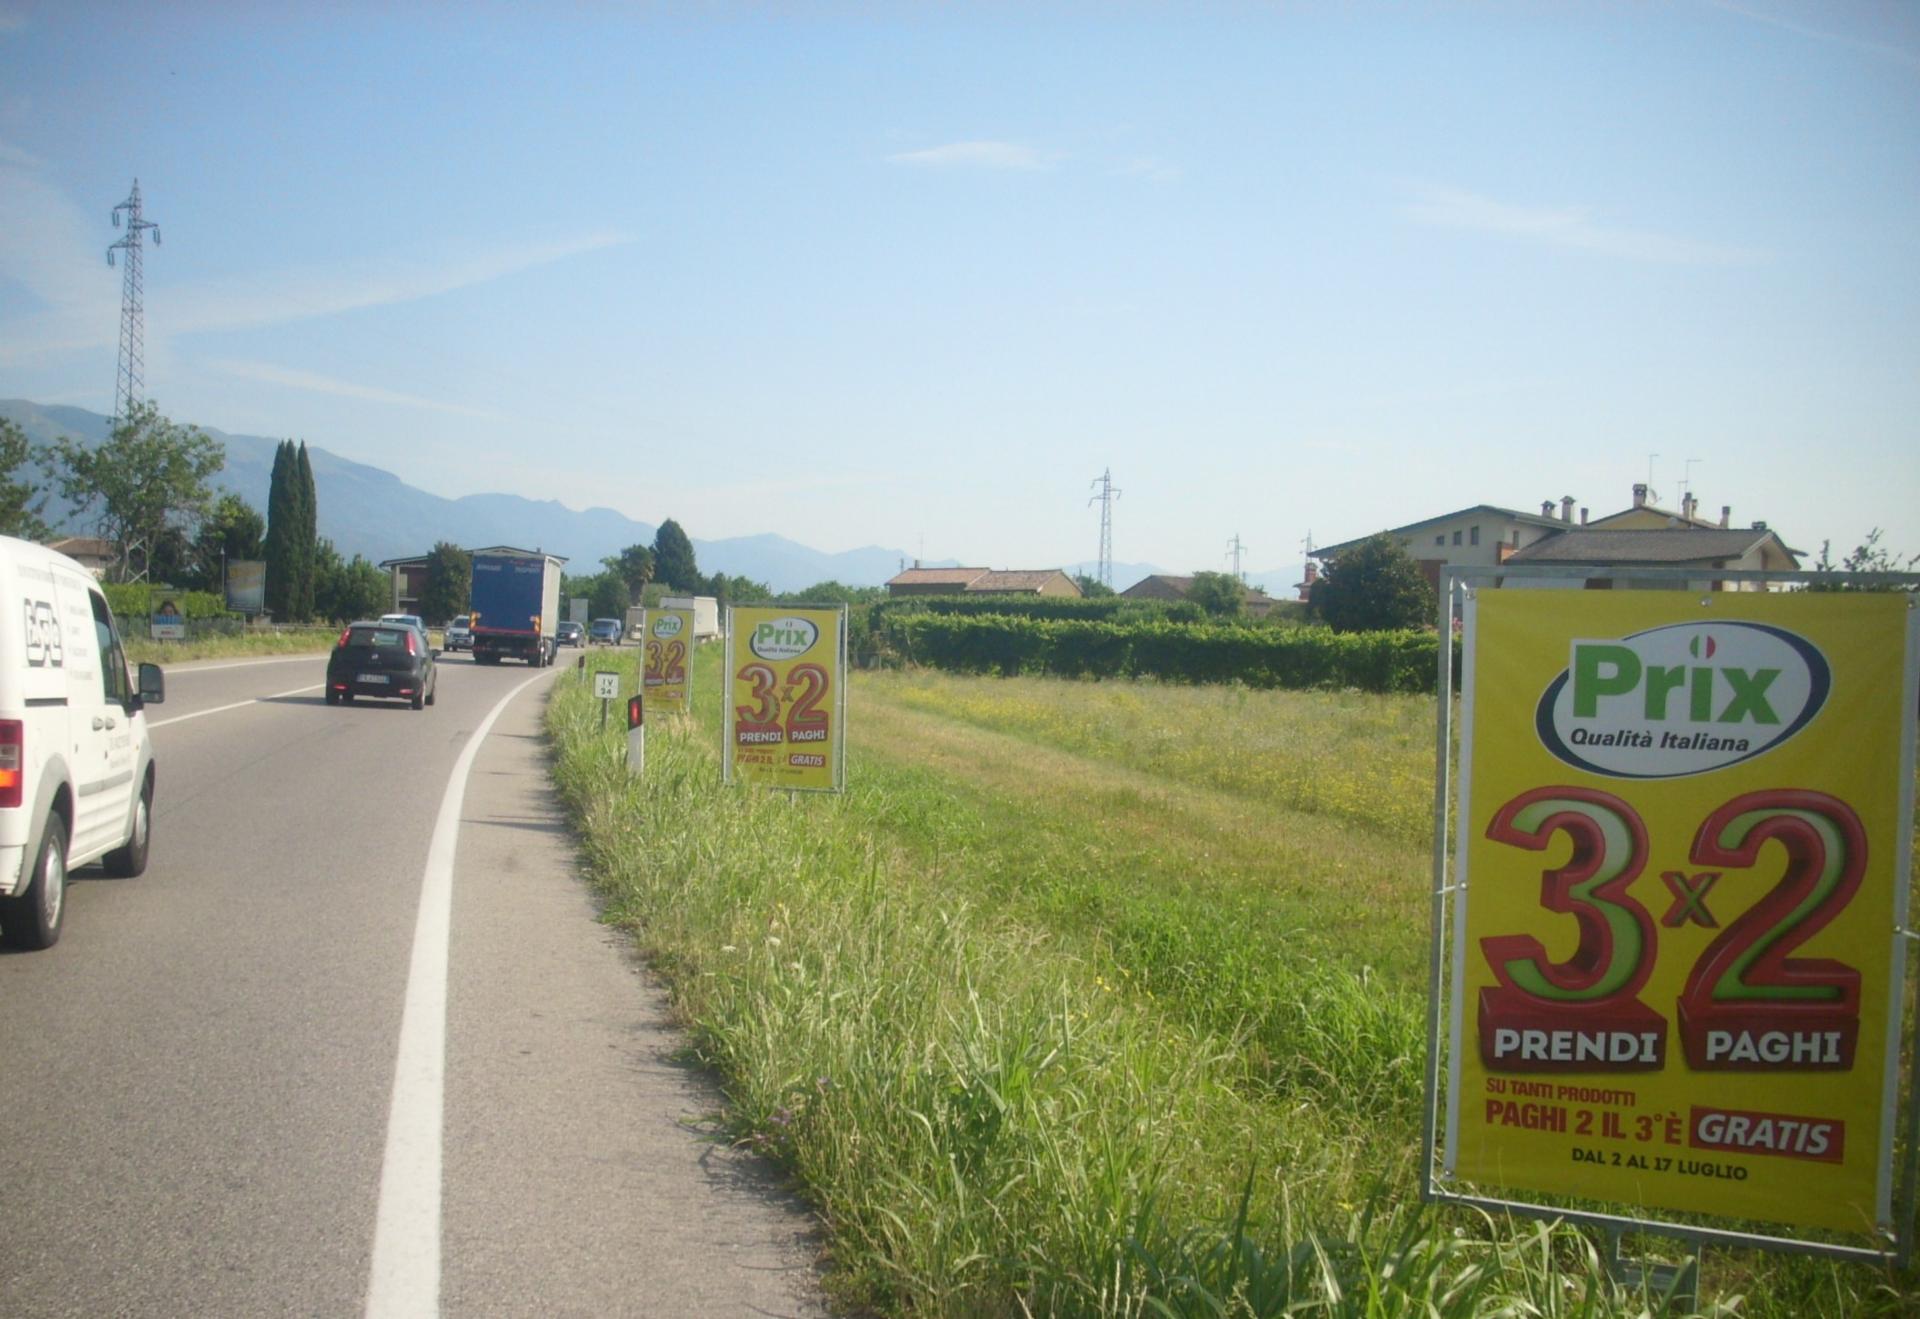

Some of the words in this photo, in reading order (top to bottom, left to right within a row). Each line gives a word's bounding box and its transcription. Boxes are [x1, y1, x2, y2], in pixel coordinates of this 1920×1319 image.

[757, 621, 808, 646] Prix
[1573, 634, 1783, 725] Prix
[740, 731, 782, 742] PRENDI
[791, 730, 825, 741] PAGHI
[1570, 728, 1653, 749] Qualità
[1660, 731, 1750, 752] Italiana
[790, 754, 824, 766] GRATIS
[1494, 1028, 1658, 1063] PRENDI
[1706, 1030, 1841, 1063] PAGHI
[1485, 1077, 1506, 1094] SU
[1510, 1080, 1553, 1100] TANTI
[1557, 1085, 1636, 1107] PRODOTTI
[1485, 1098, 1568, 1134] PAGHI
[1575, 1110, 1594, 1137] 2
[1601, 1112, 1627, 1140] IL
[1696, 1113, 1832, 1155] GRATIS
[1572, 1147, 1606, 1166] DAL
[1611, 1152, 1622, 1167] 2
[1627, 1154, 1650, 1170] AL
[1653, 1157, 1672, 1173] 17
[1677, 1160, 1749, 1181] LUGLIO
